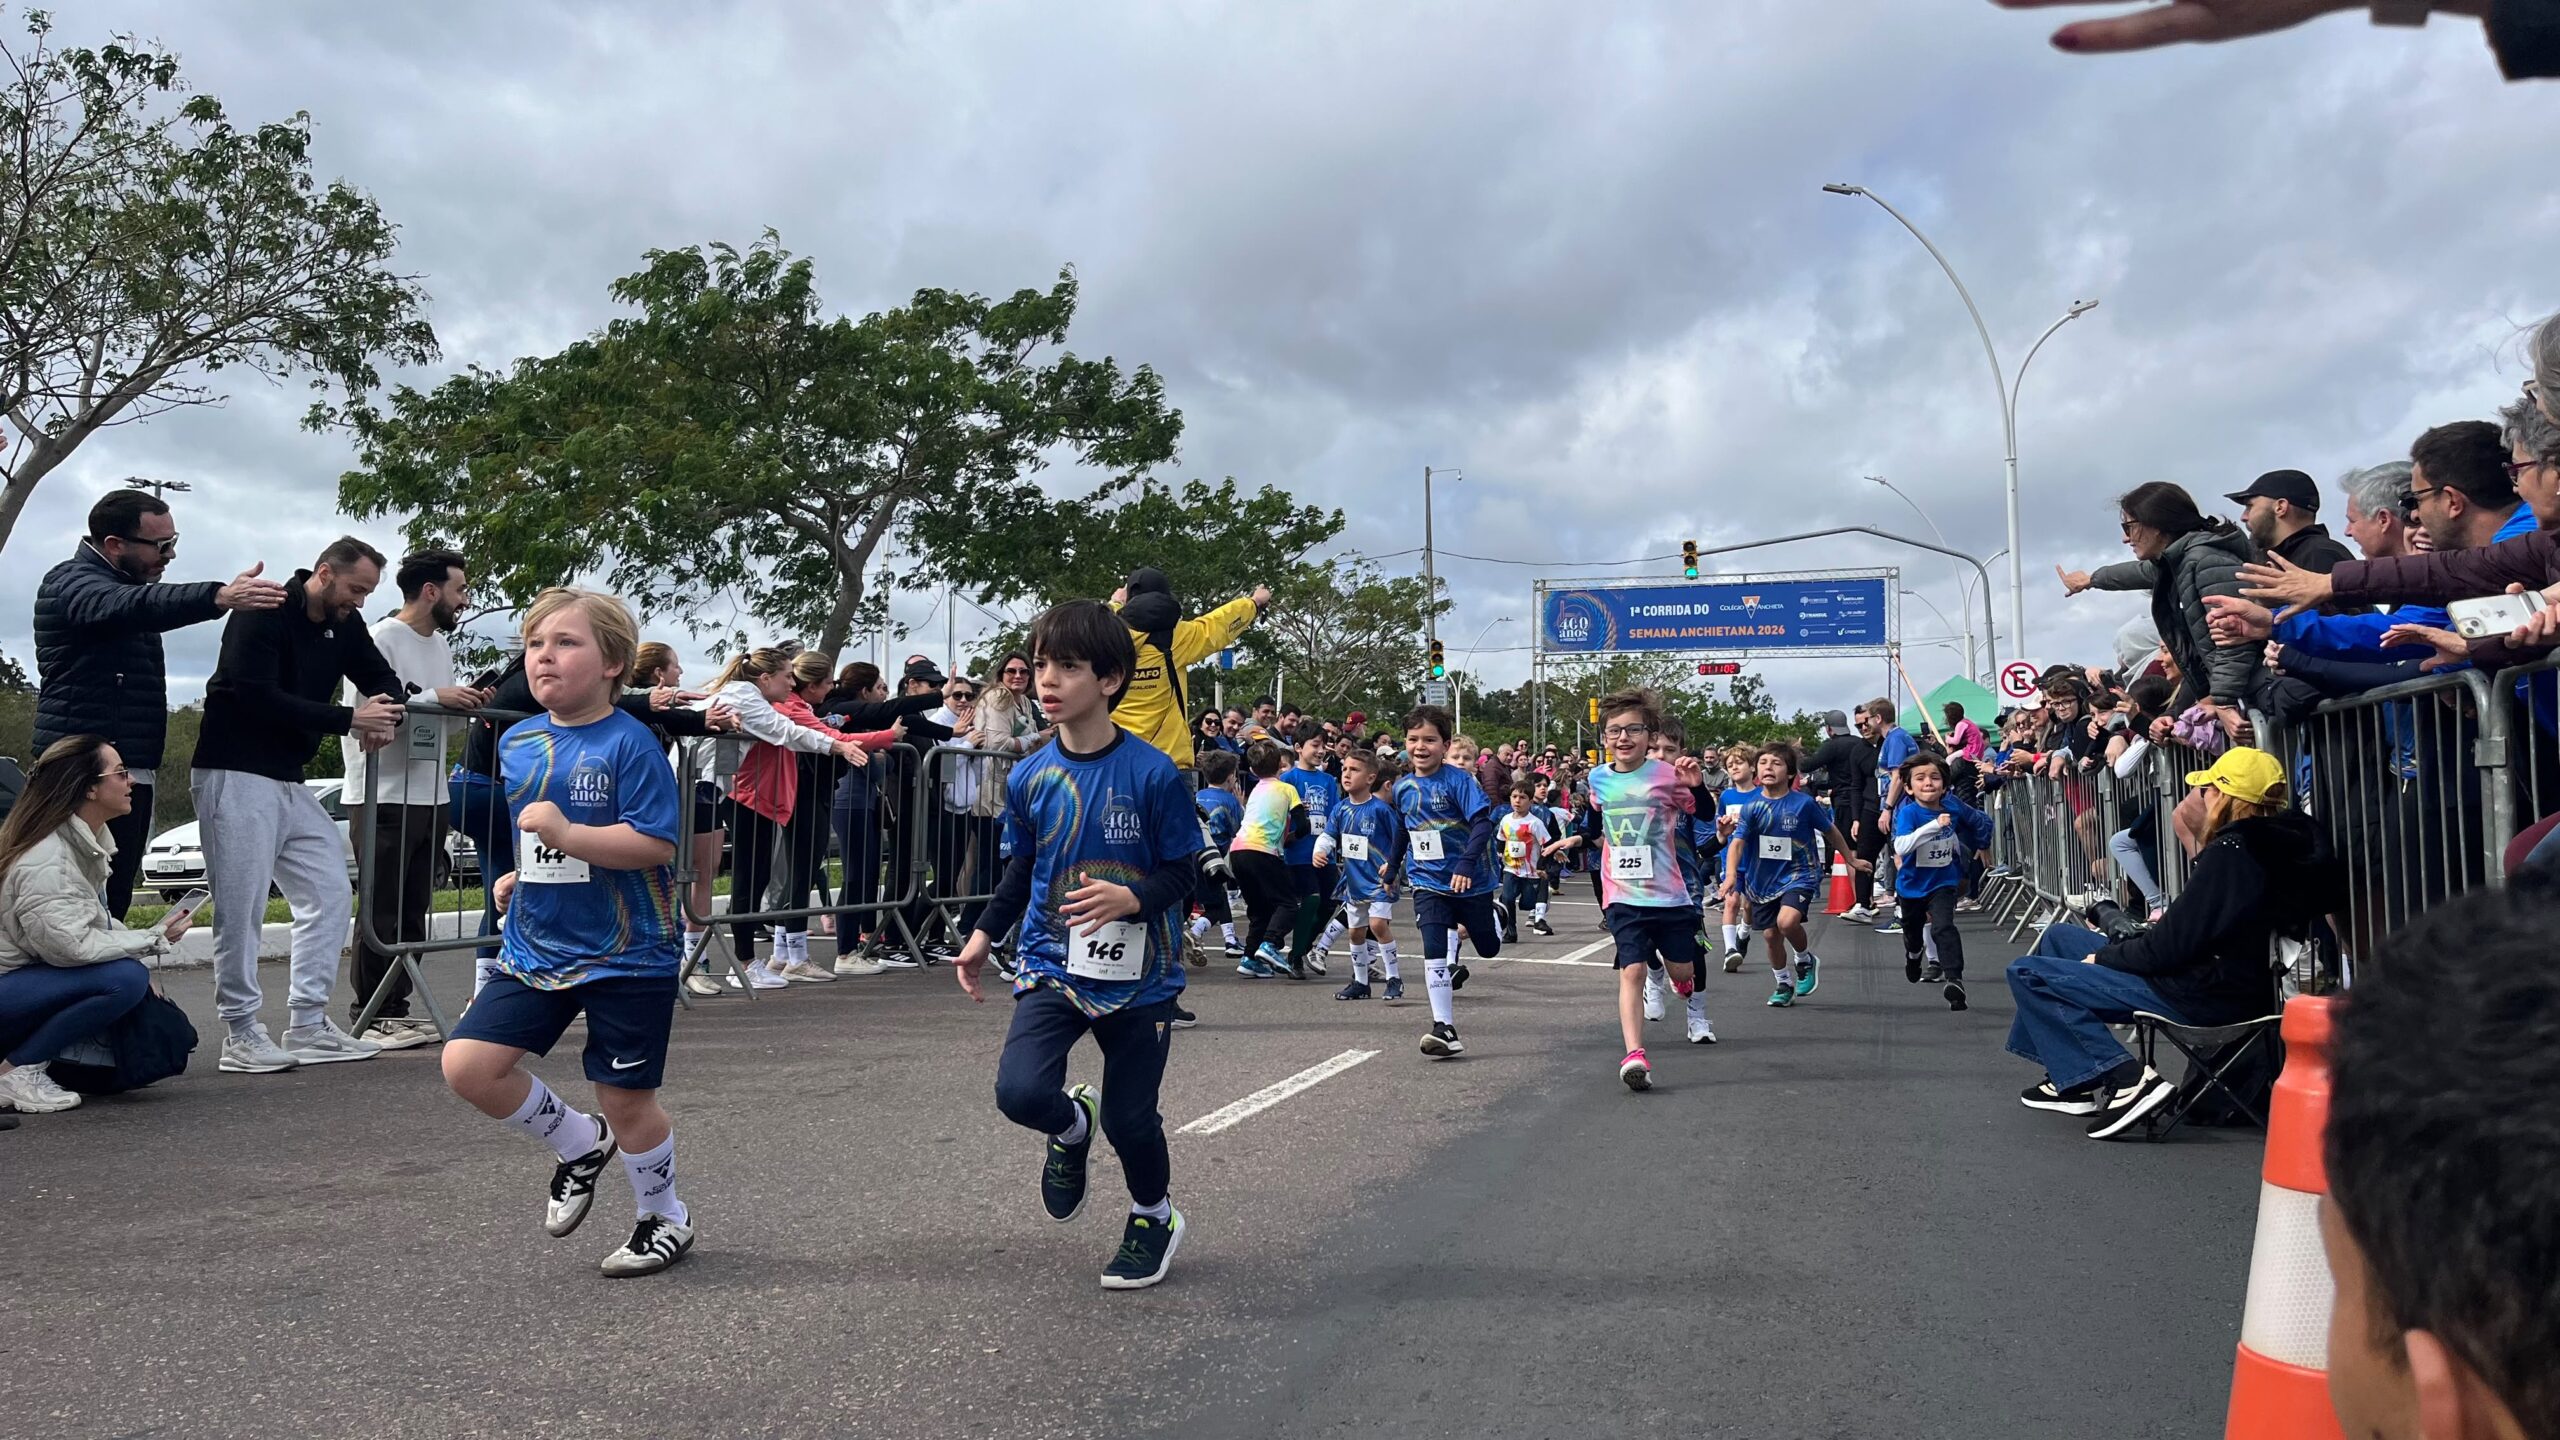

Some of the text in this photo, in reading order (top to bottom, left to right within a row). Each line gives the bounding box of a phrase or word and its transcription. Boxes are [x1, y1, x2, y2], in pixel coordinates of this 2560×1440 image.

[1629, 603, 1710, 617] 1ª CORRIDA DO
[1558, 629, 1589, 638] anos
[1628, 624, 1786, 639] SEMANA ANCHIETANA 2026
[1133, 669, 1160, 679] RAFO
[2013, 669, 2027, 691] E
[569, 789, 609, 802] anos
[1104, 828, 1141, 840] anos
[1349, 843, 1360, 852] 66
[1420, 841, 1430, 851] 61
[1768, 844, 1782, 852] 30
[1619, 857, 1642, 869] 225
[1087, 940, 1126, 961] 146
